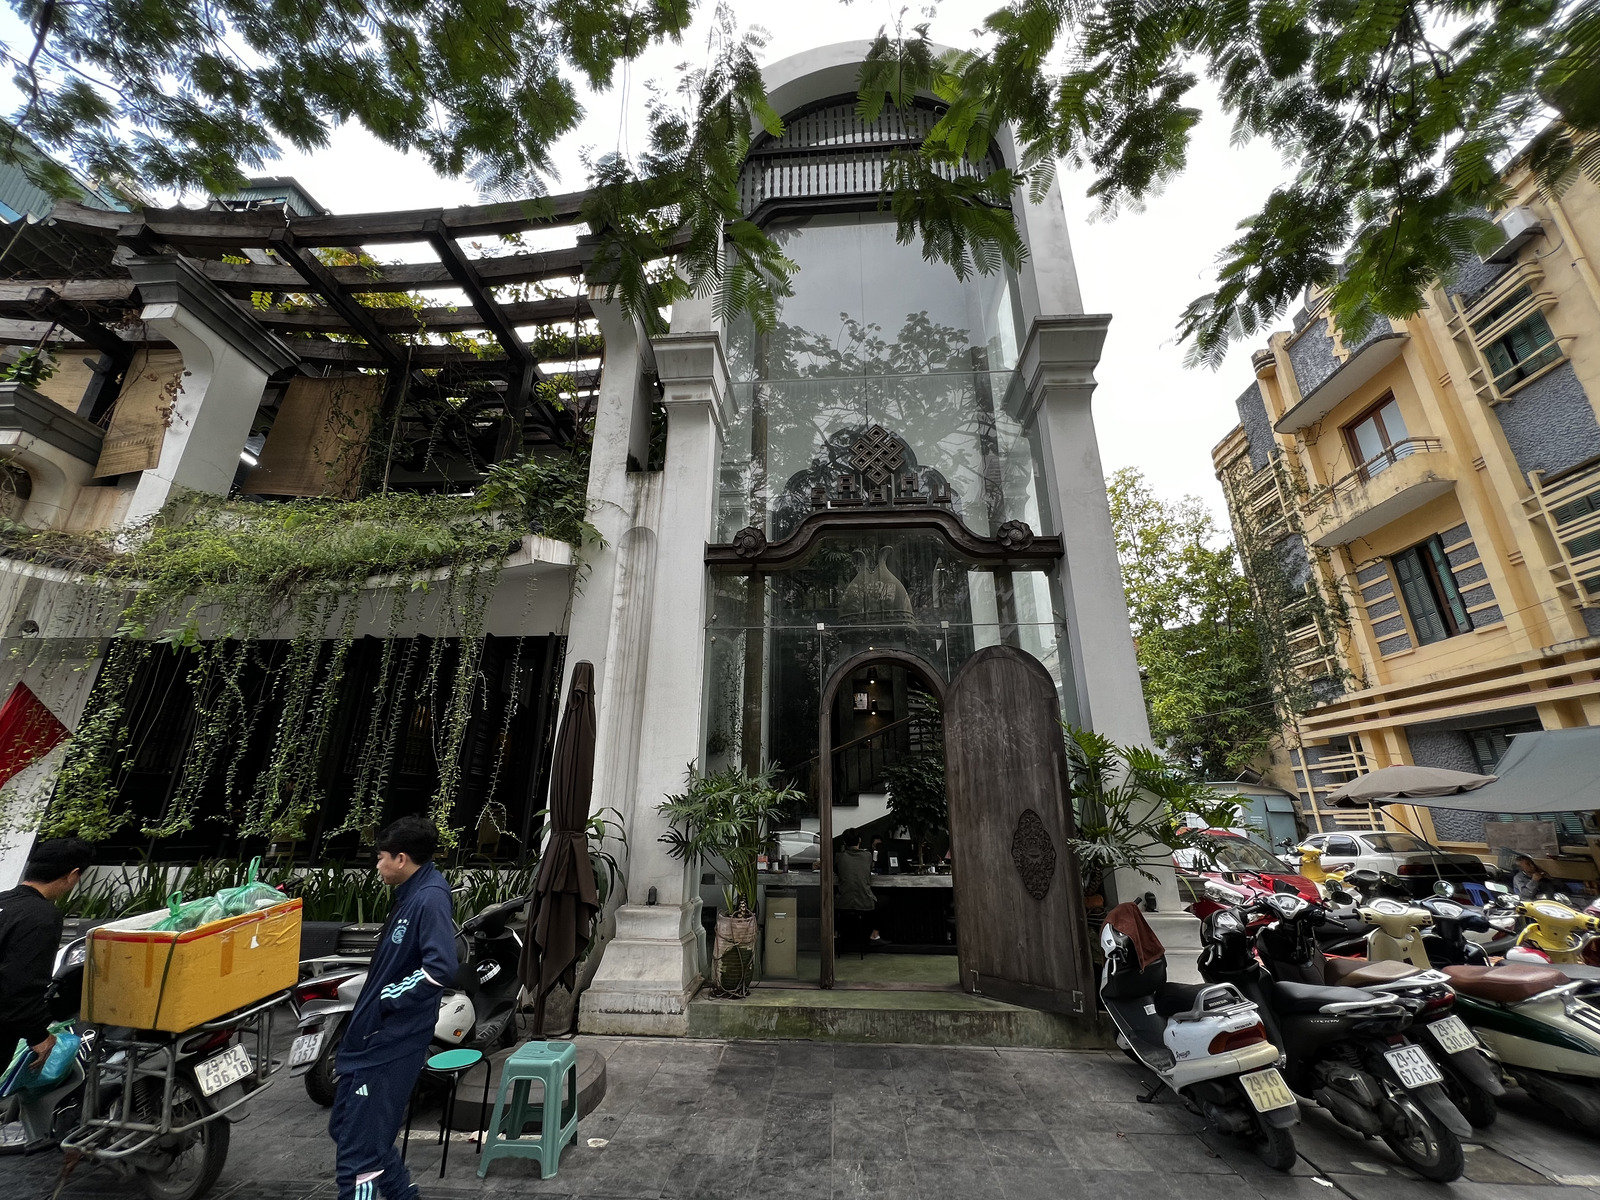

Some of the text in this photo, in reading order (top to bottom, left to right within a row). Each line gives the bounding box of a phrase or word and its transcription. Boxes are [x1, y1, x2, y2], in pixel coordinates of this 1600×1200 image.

[1208, 999, 1229, 1007] HONDA
[1234, 1022, 1253, 1030] HONDA
[1433, 1019, 1462, 1037] 29-F1
[1441, 1031, 1475, 1051] 430.68
[202, 1050, 241, 1077] 29-D2
[1391, 1049, 1425, 1069] 29-C1
[205, 1060, 249, 1092] 496.16
[1246, 1070, 1279, 1091] 29-K6
[1400, 1064, 1439, 1086] 676.81
[1254, 1088, 1288, 1109] 7744
